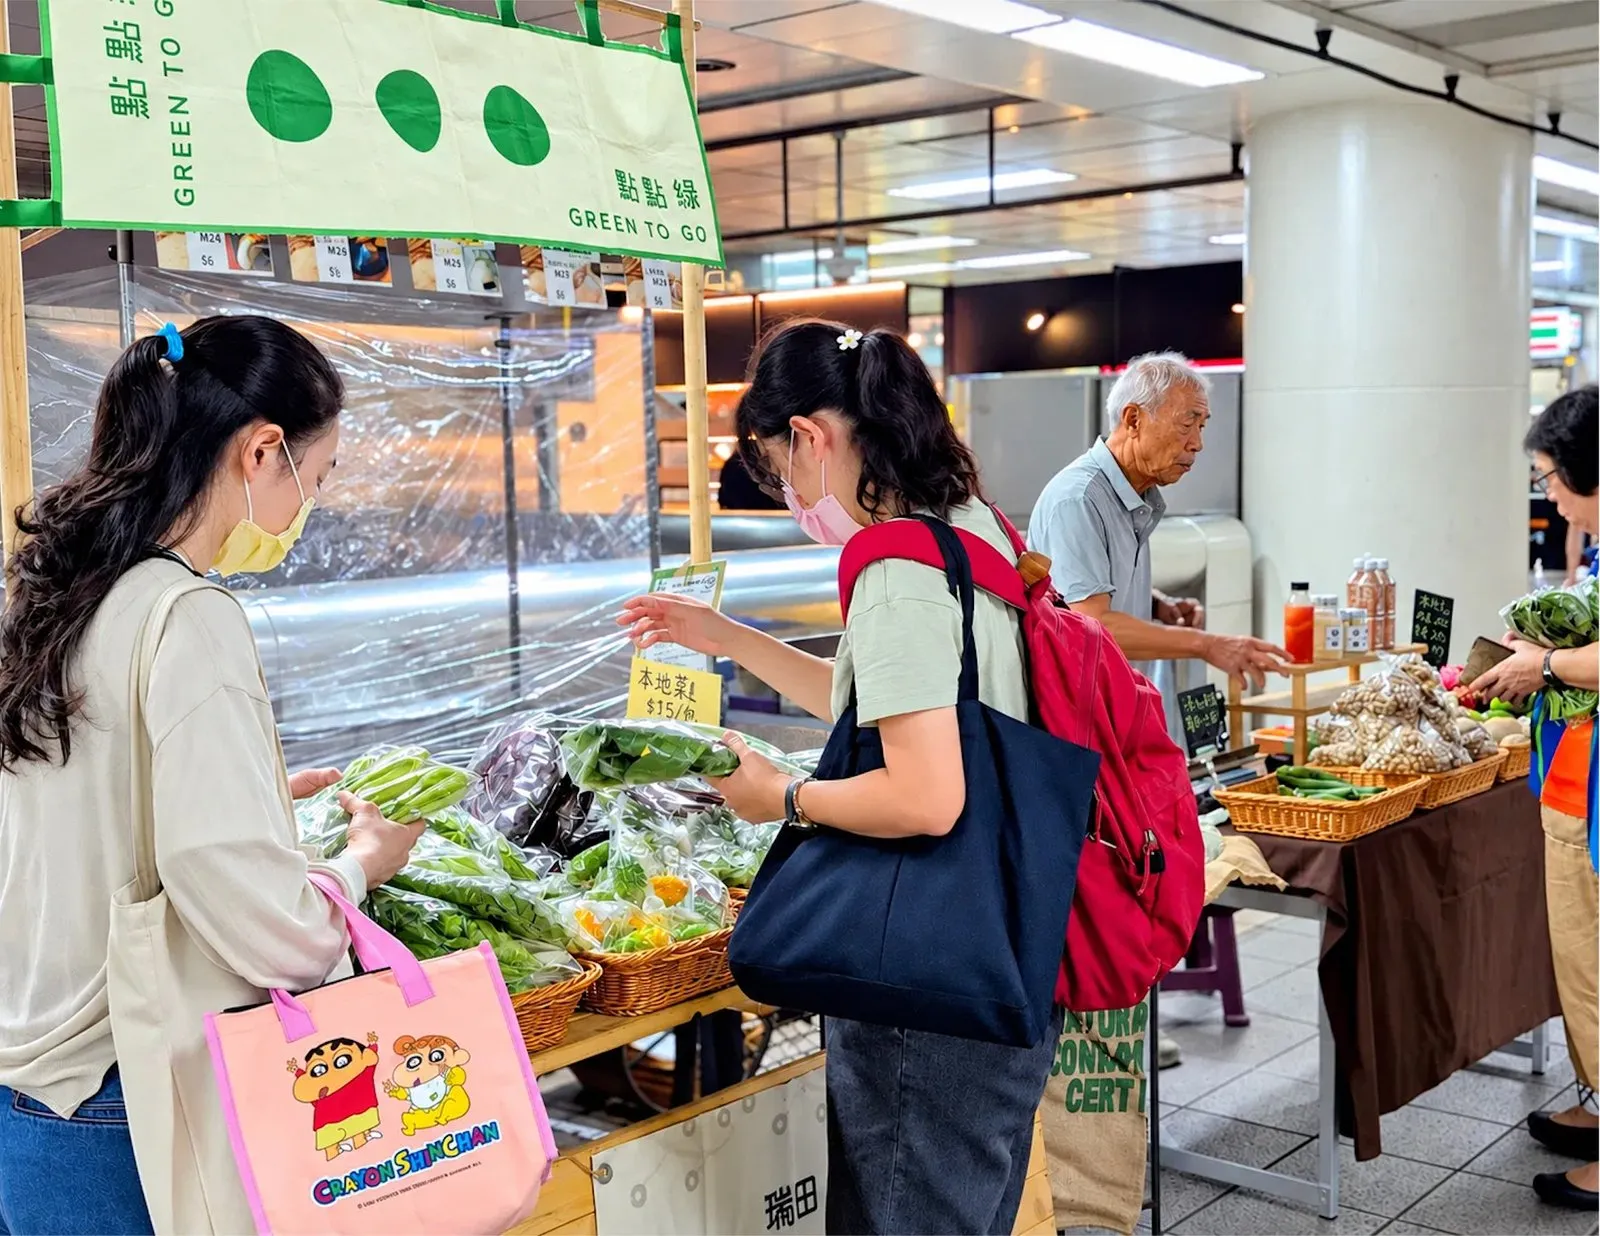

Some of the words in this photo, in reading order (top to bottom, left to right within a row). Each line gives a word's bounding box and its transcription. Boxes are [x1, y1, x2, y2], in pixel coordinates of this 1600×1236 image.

[103, 0, 150, 119] 點點
[160, 38, 184, 77] TO
[168, 96, 195, 206] GREEN
[615, 168, 700, 210] 點點綠
[200, 233, 222, 244] M24
[569, 207, 638, 235] GREEN
[644, 220, 670, 240] TO
[681, 224, 707, 243] GO
[313, 1160, 395, 1205] CRAYON
[394, 1121, 500, 1177] SHINCHAN
[764, 1175, 818, 1231] 瑞田
